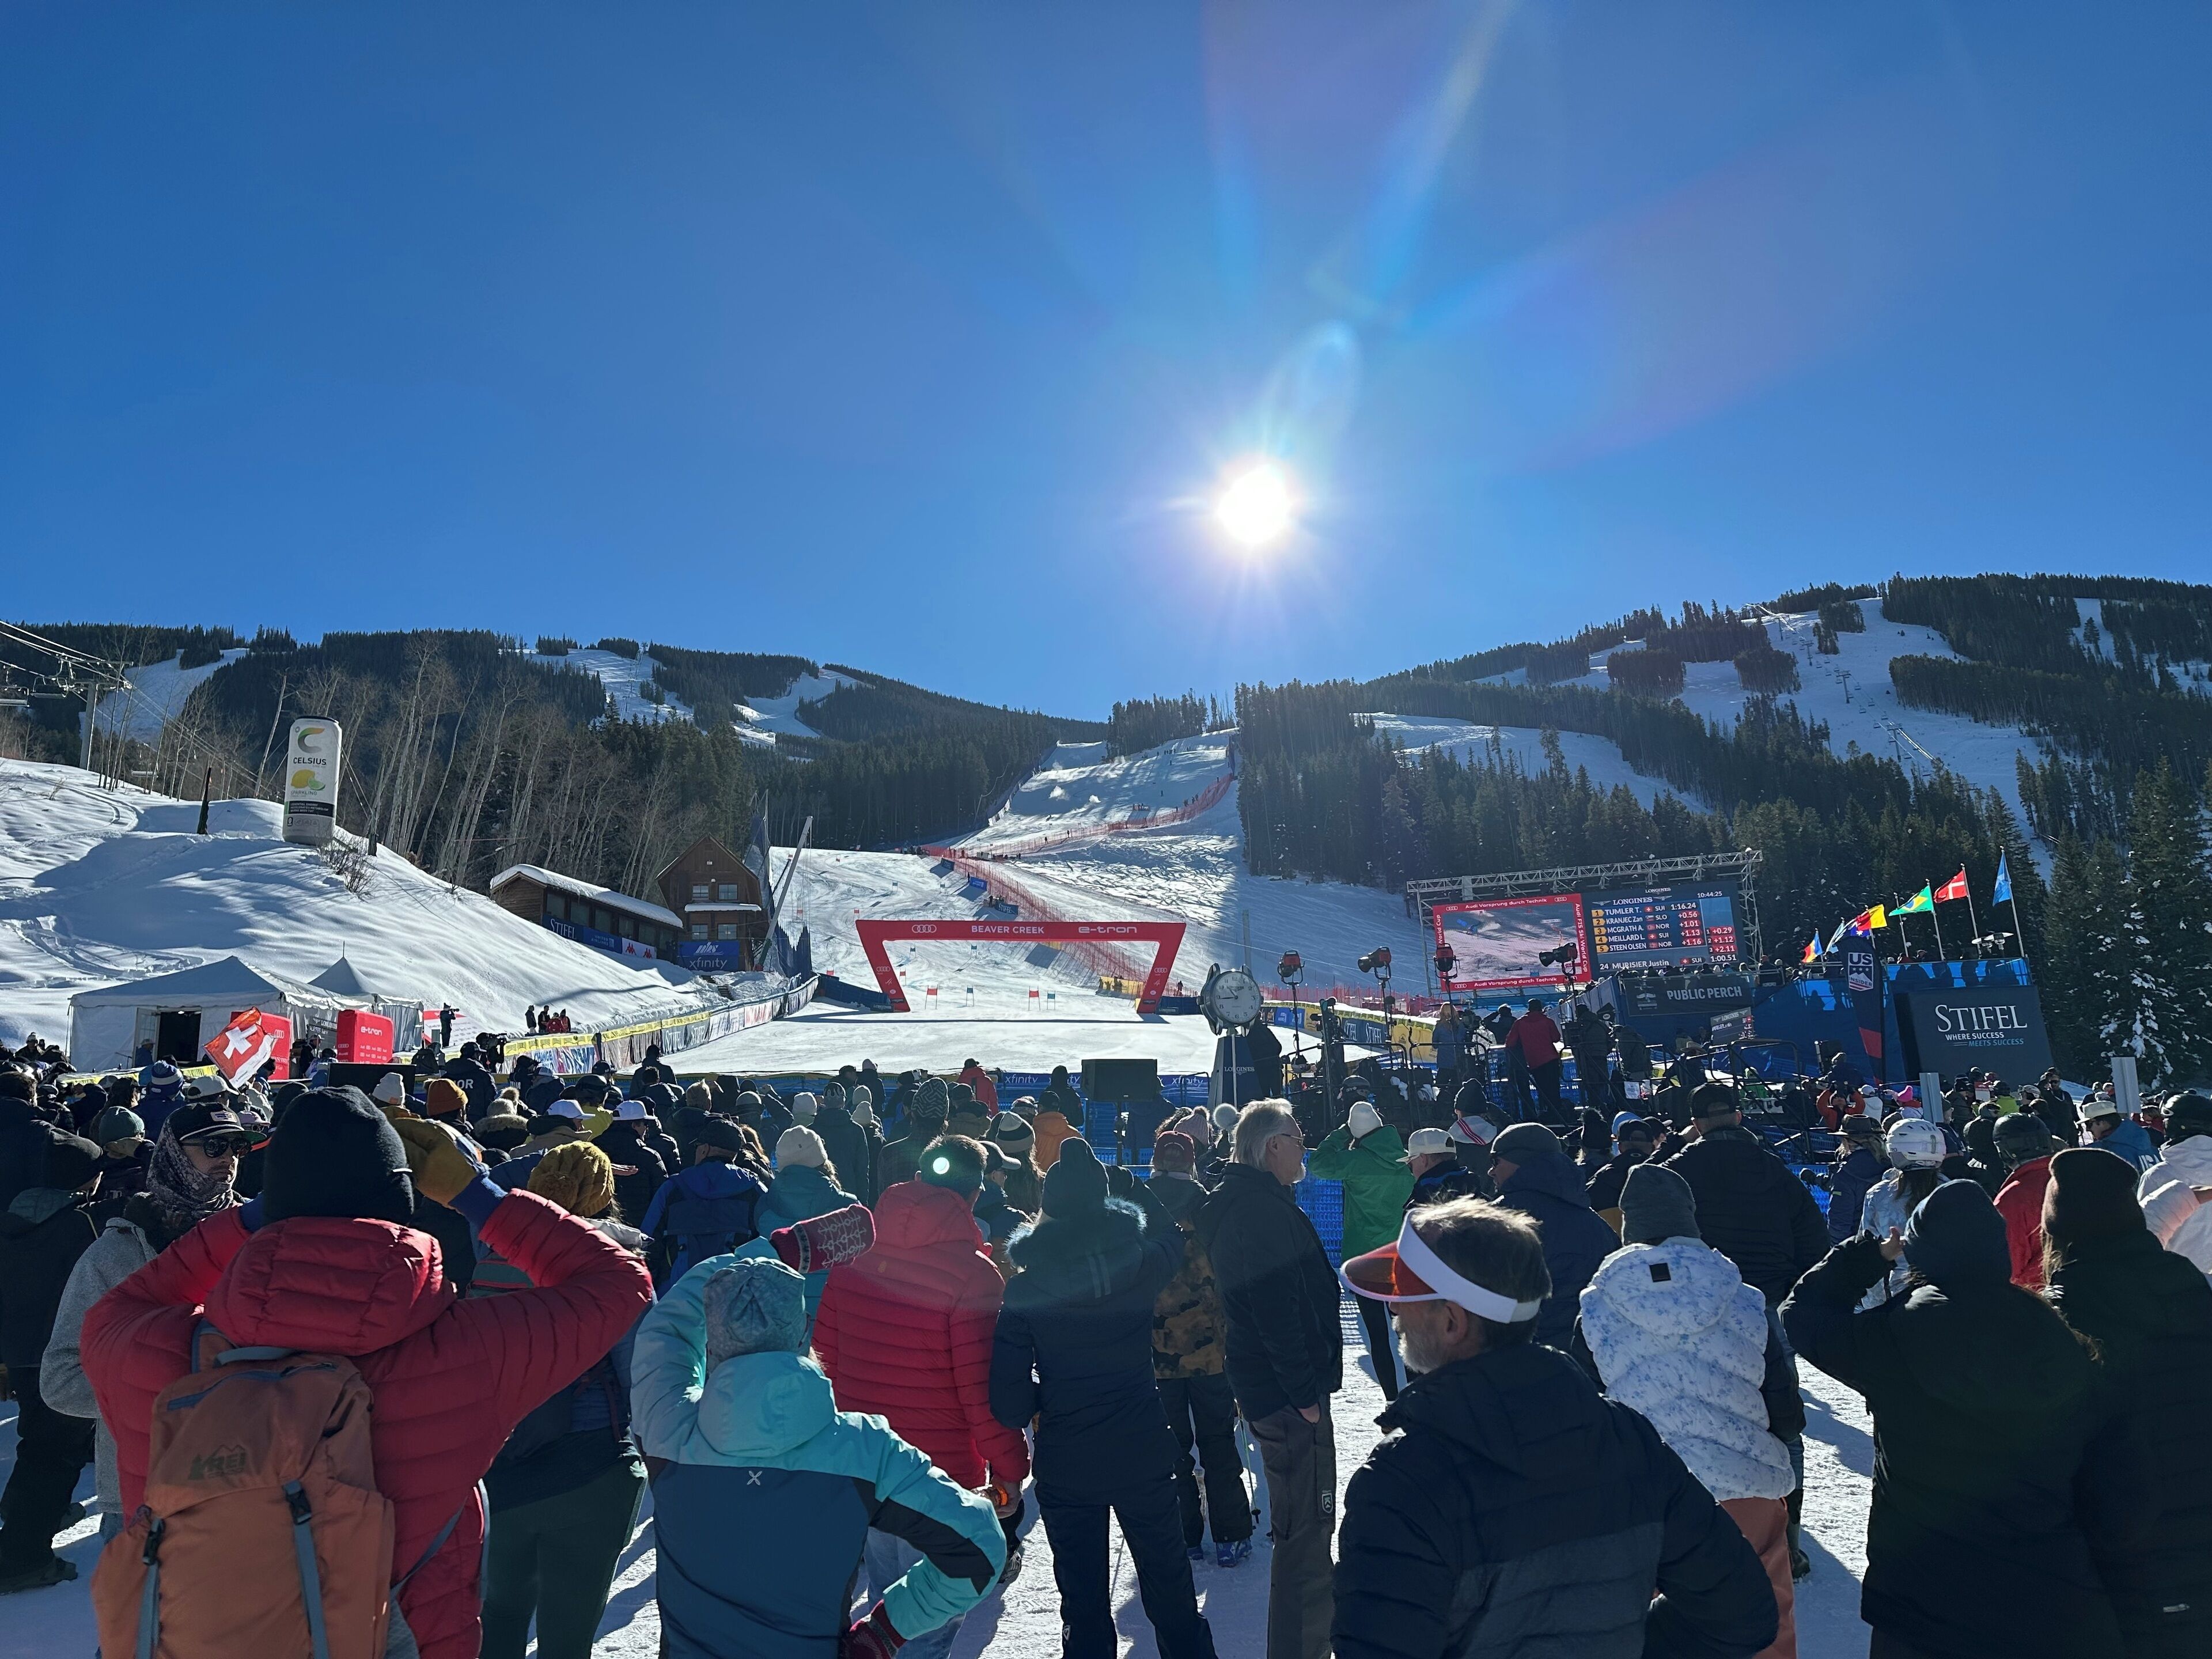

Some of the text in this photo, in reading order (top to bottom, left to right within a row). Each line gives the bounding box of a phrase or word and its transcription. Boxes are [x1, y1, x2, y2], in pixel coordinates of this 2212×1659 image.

[293, 757, 327, 766] CELSIUS
[1613, 897, 1653, 905] LONGINES
[1606, 916, 1632, 925] KRANJEC
[551, 918, 577, 940] STIFEL
[689, 957, 728, 969] xfinity
[1850, 953, 1872, 965] US
[1612, 961, 1647, 969] MURISIER
[1849, 976, 1872, 987] INSIDER
[1666, 986, 1743, 1000] PUBLIC PERCH
[1935, 1004, 2028, 1032] STIFEL
[361, 1027, 382, 1036] e-tron
[455, 1079, 474, 1089] OR
[1005, 1074, 1038, 1084] xfinity
